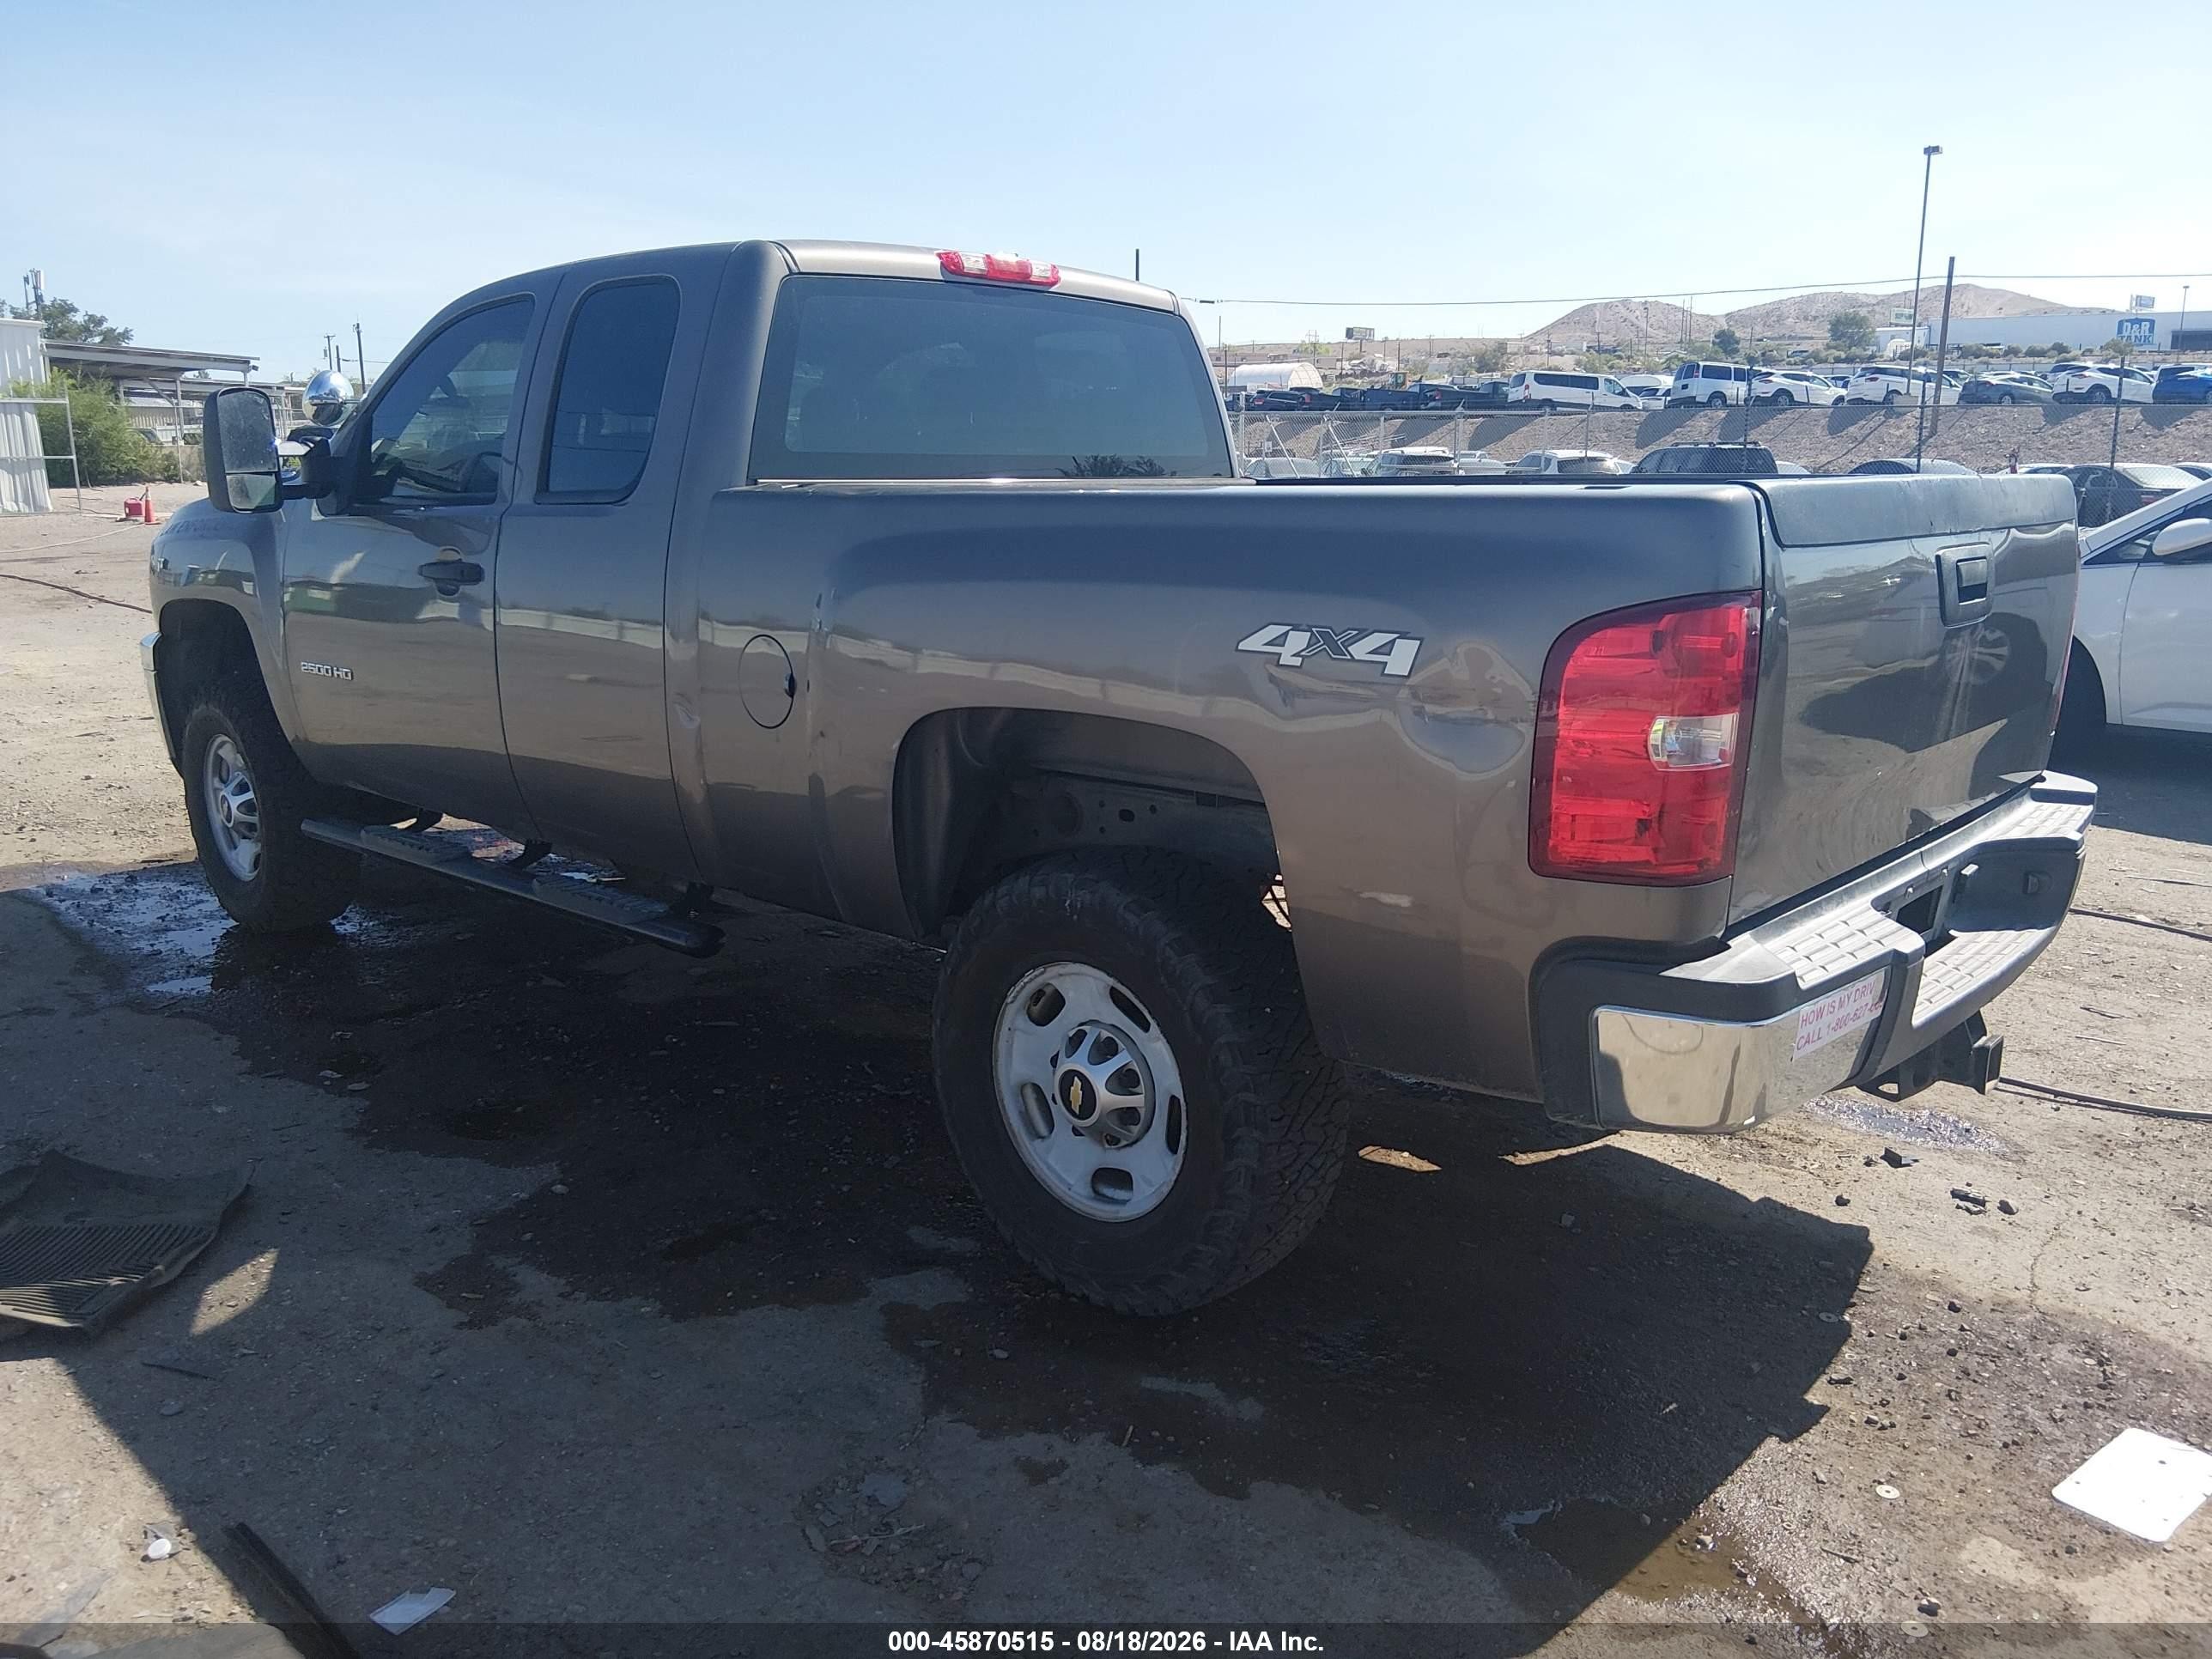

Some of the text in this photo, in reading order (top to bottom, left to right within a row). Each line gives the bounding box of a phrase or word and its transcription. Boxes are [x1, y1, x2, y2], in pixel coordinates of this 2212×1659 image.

[2123, 321, 2150, 335] D&R
[2118, 335, 2152, 343] TANK
[301, 661, 353, 680] 2500 HD
[1801, 1005, 1825, 1029] HOW
[1826, 1000, 1836, 1016] IS
[1838, 990, 1853, 1010] MY
[1796, 1026, 1822, 1050] CALL
